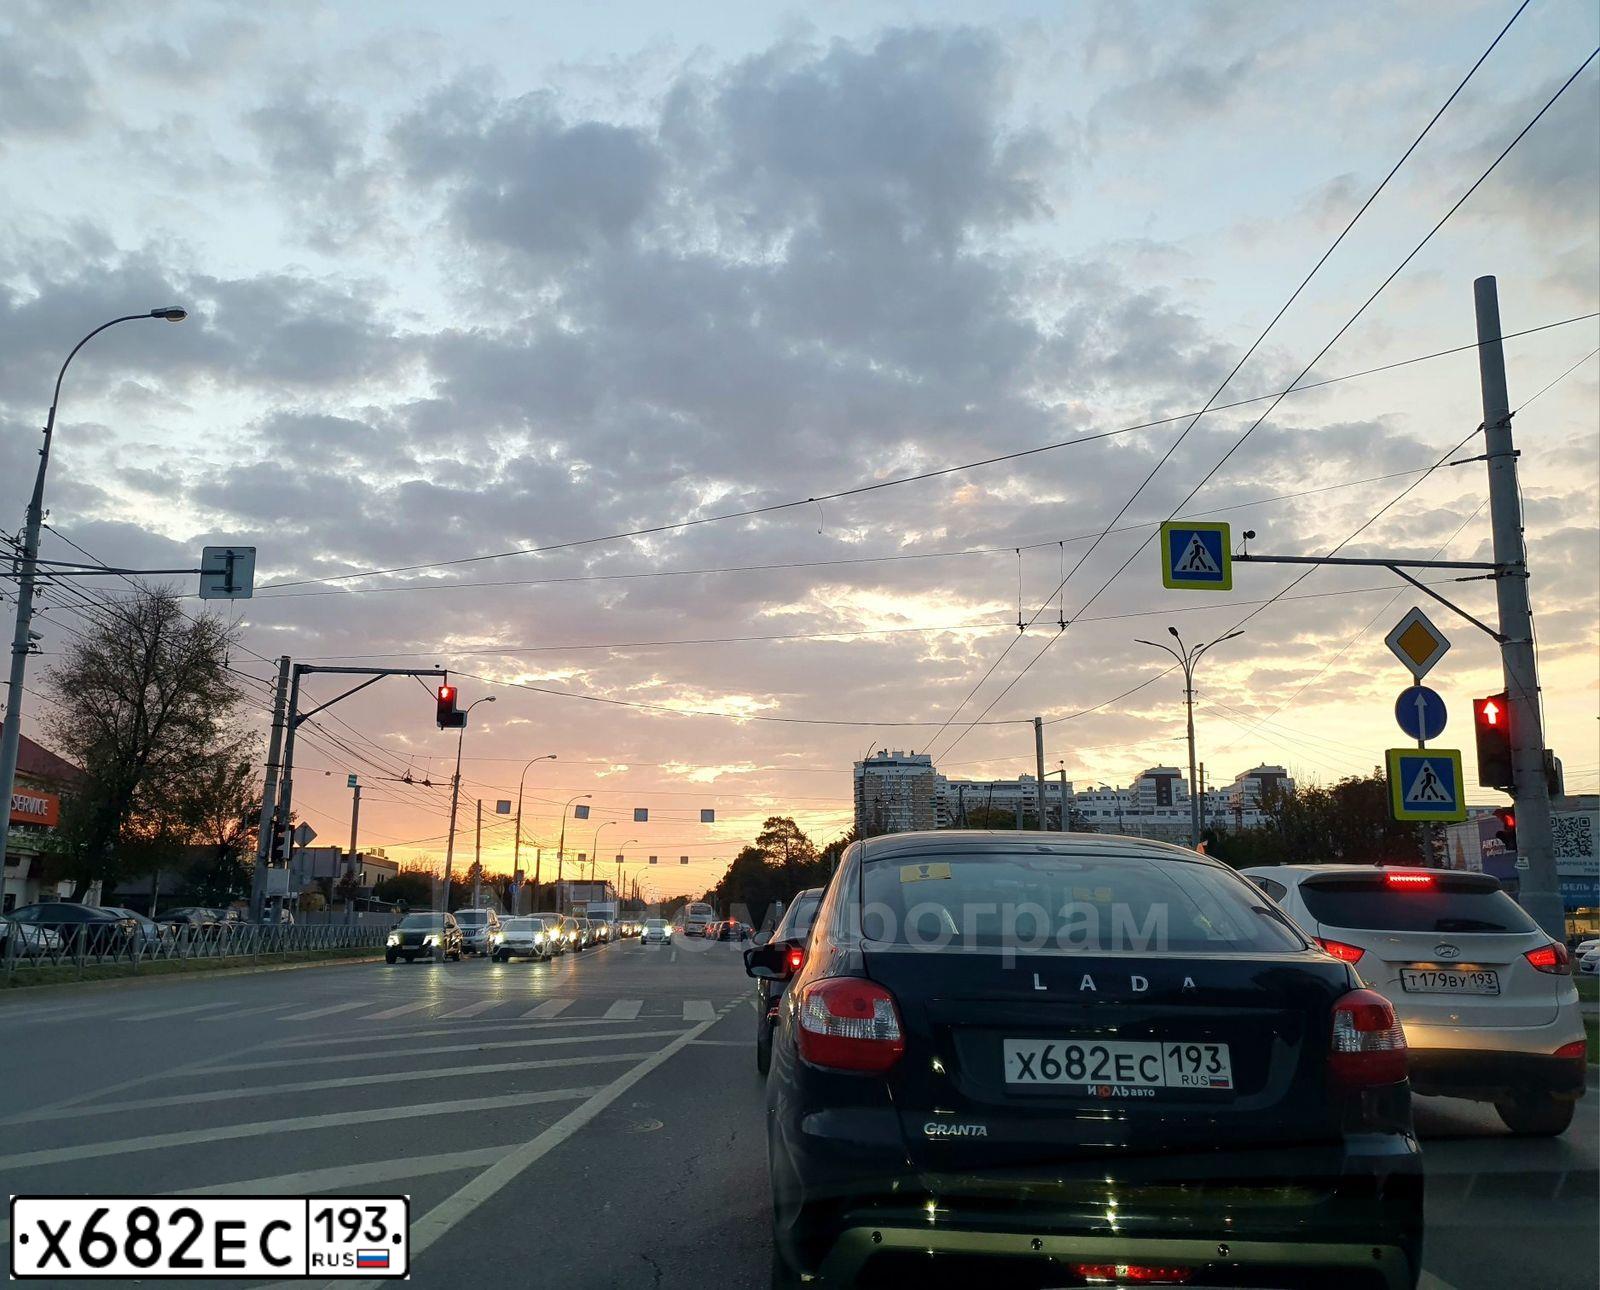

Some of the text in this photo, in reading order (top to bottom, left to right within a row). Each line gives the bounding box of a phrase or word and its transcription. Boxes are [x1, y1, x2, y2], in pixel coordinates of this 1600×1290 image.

[12, 793, 49, 816] SERVICE
[1033, 973, 1197, 992] LADA
[1470, 973, 1493, 985] 193
[1015, 1044, 1222, 1082] Х682ЕС 193
[1181, 1074, 1209, 1086] RUS
[1131, 1087, 1156, 1097] авто
[923, 1122, 988, 1137] GRANTA
